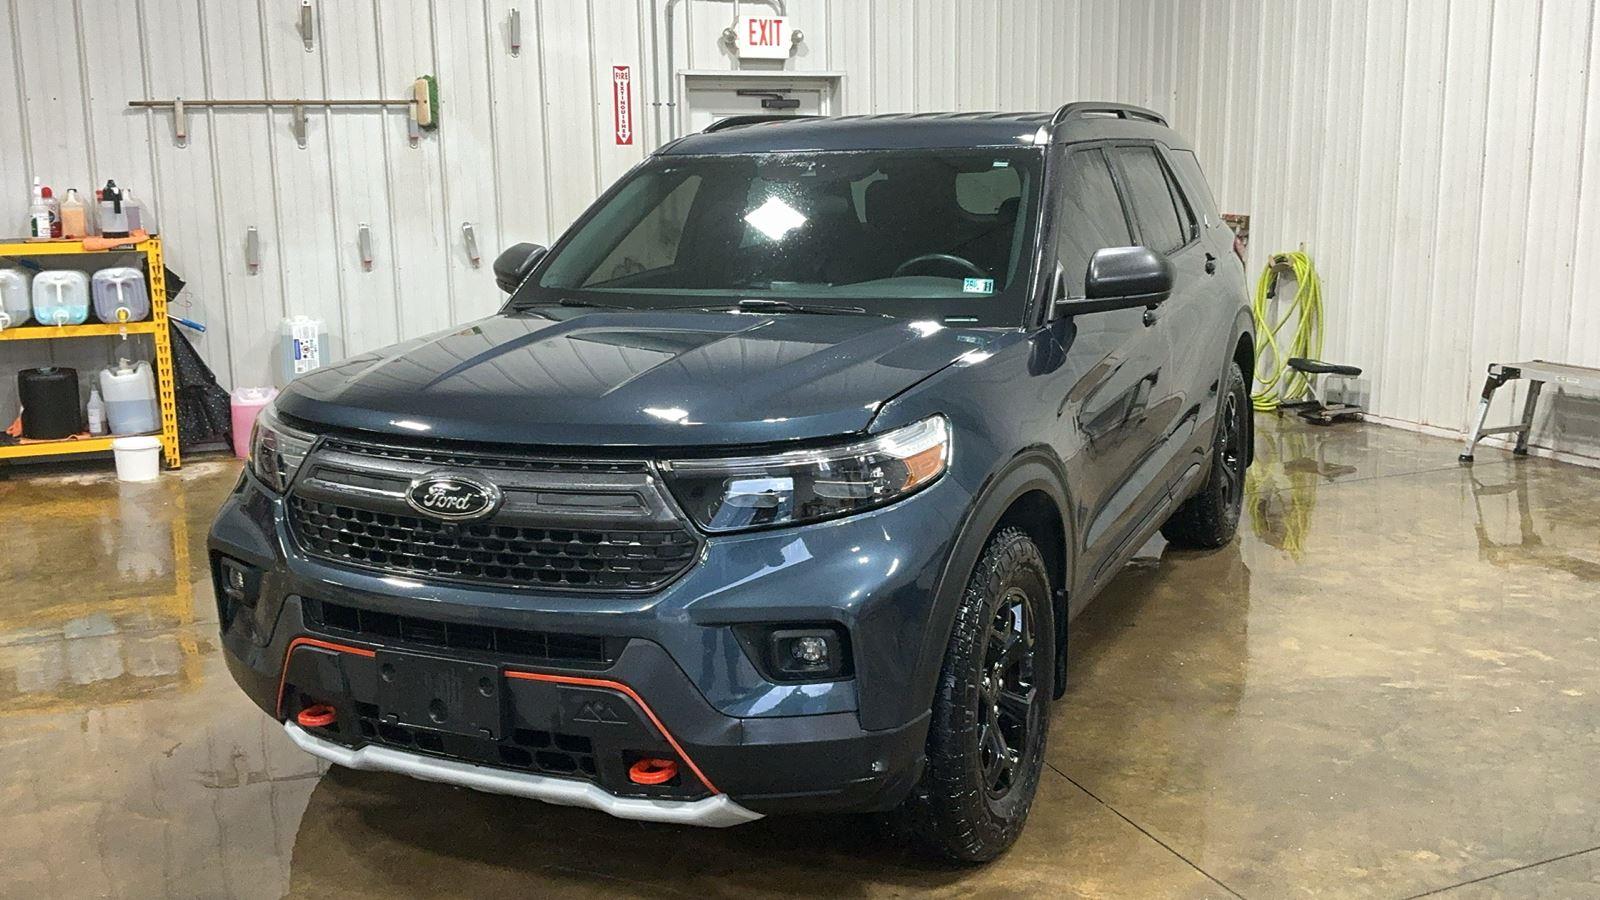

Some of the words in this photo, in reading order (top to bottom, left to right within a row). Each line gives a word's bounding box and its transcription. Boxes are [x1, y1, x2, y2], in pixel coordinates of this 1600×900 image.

[749, 19, 783, 46] EXIT
[615, 72, 629, 80] FIRE
[423, 482, 472, 510] Ford
